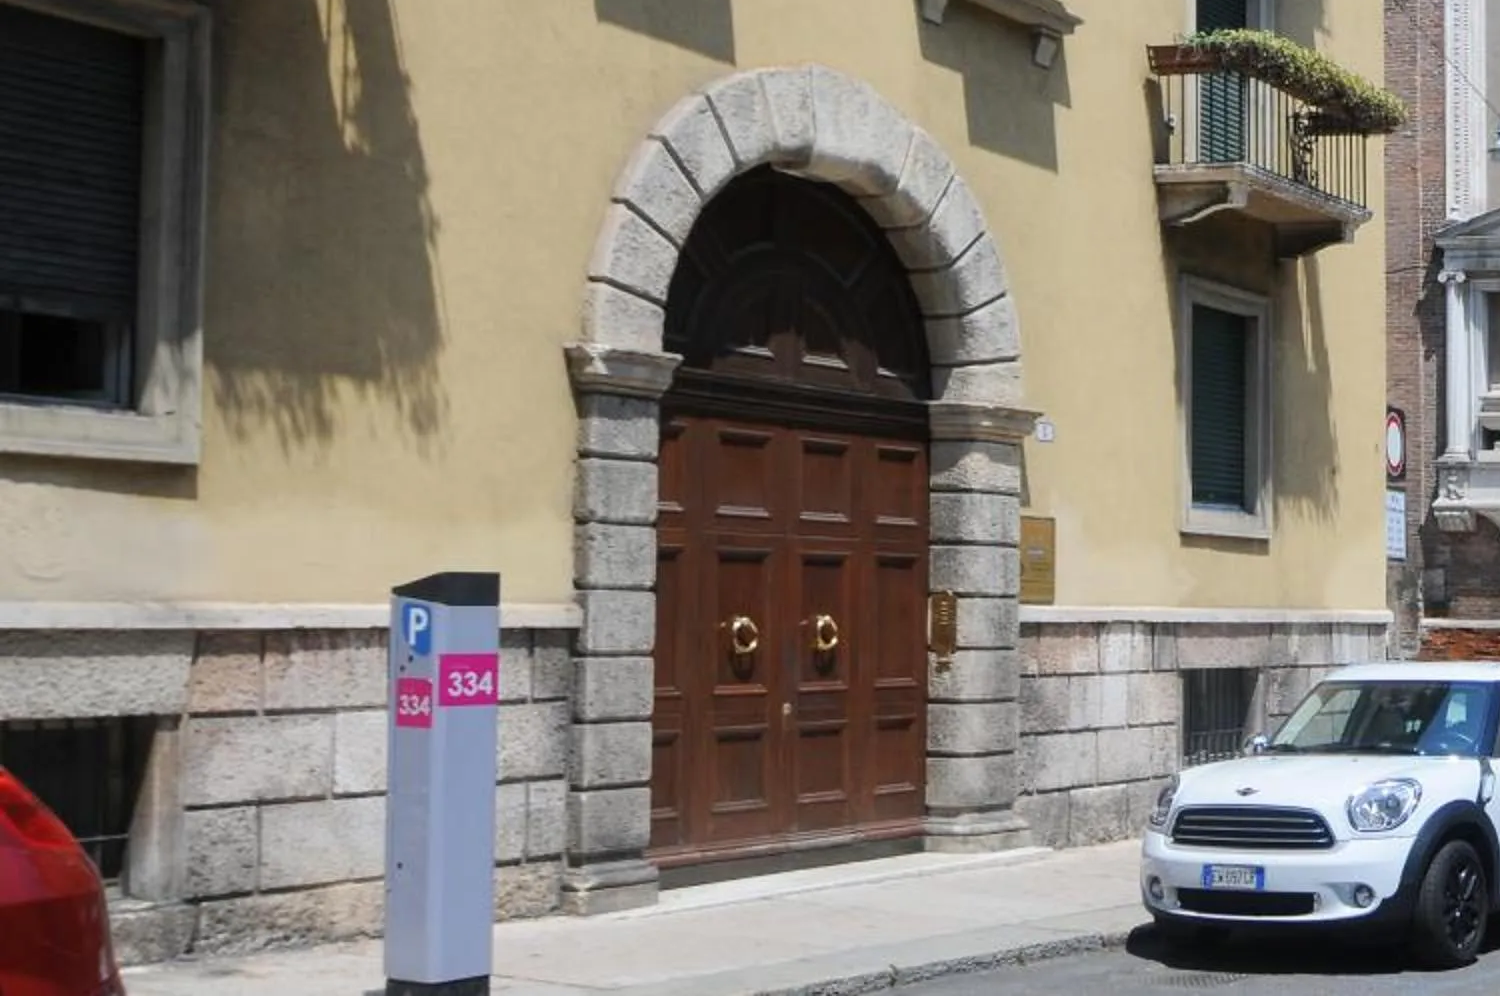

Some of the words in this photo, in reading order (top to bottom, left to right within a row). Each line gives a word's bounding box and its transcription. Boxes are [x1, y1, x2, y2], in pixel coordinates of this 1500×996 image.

[408, 607, 428, 646] P
[447, 671, 493, 697] 334
[399, 694, 431, 716] 334
